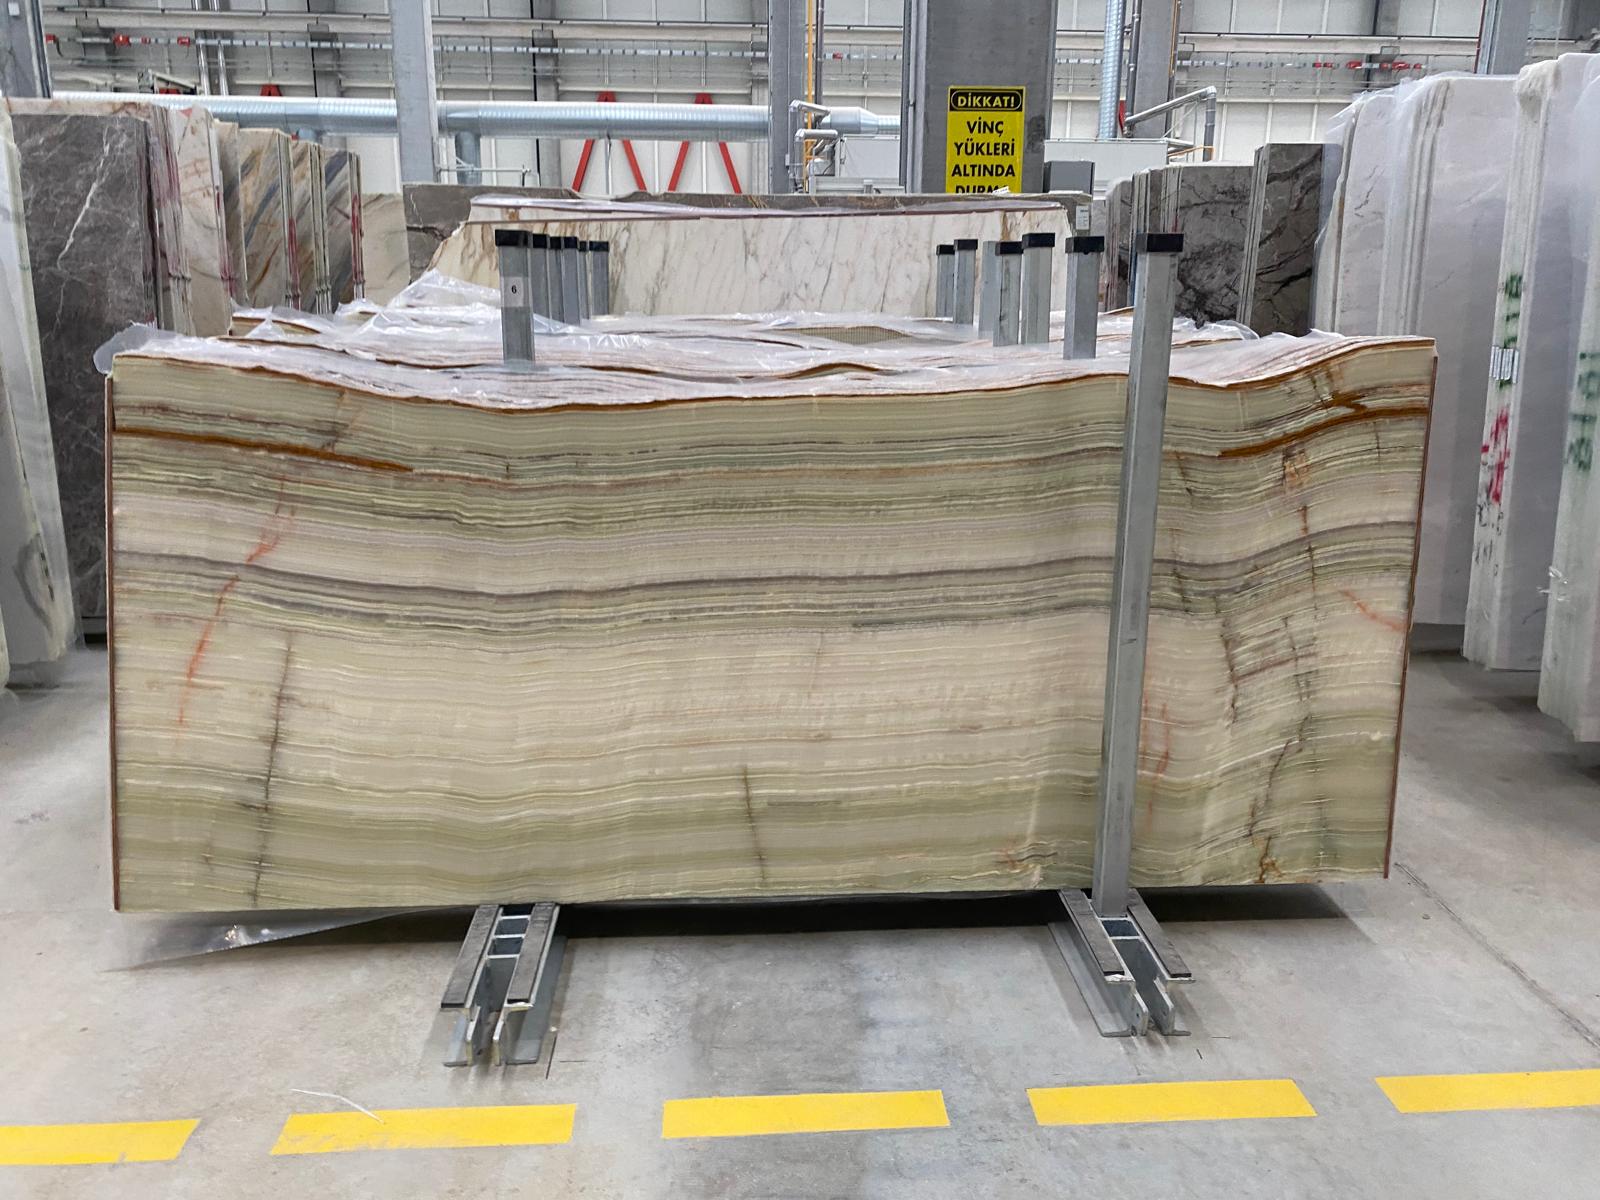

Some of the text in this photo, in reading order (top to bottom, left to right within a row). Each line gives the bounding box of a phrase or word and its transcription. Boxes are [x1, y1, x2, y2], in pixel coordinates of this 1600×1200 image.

[957, 92, 1015, 107] DİKKAT!
[966, 116, 1004, 137] VİNÇ
[954, 138, 1015, 156] YÜKLERİ
[951, 164, 1016, 177] ALTINDA
[955, 185, 1007, 194] DURM
[511, 284, 517, 294] 6
